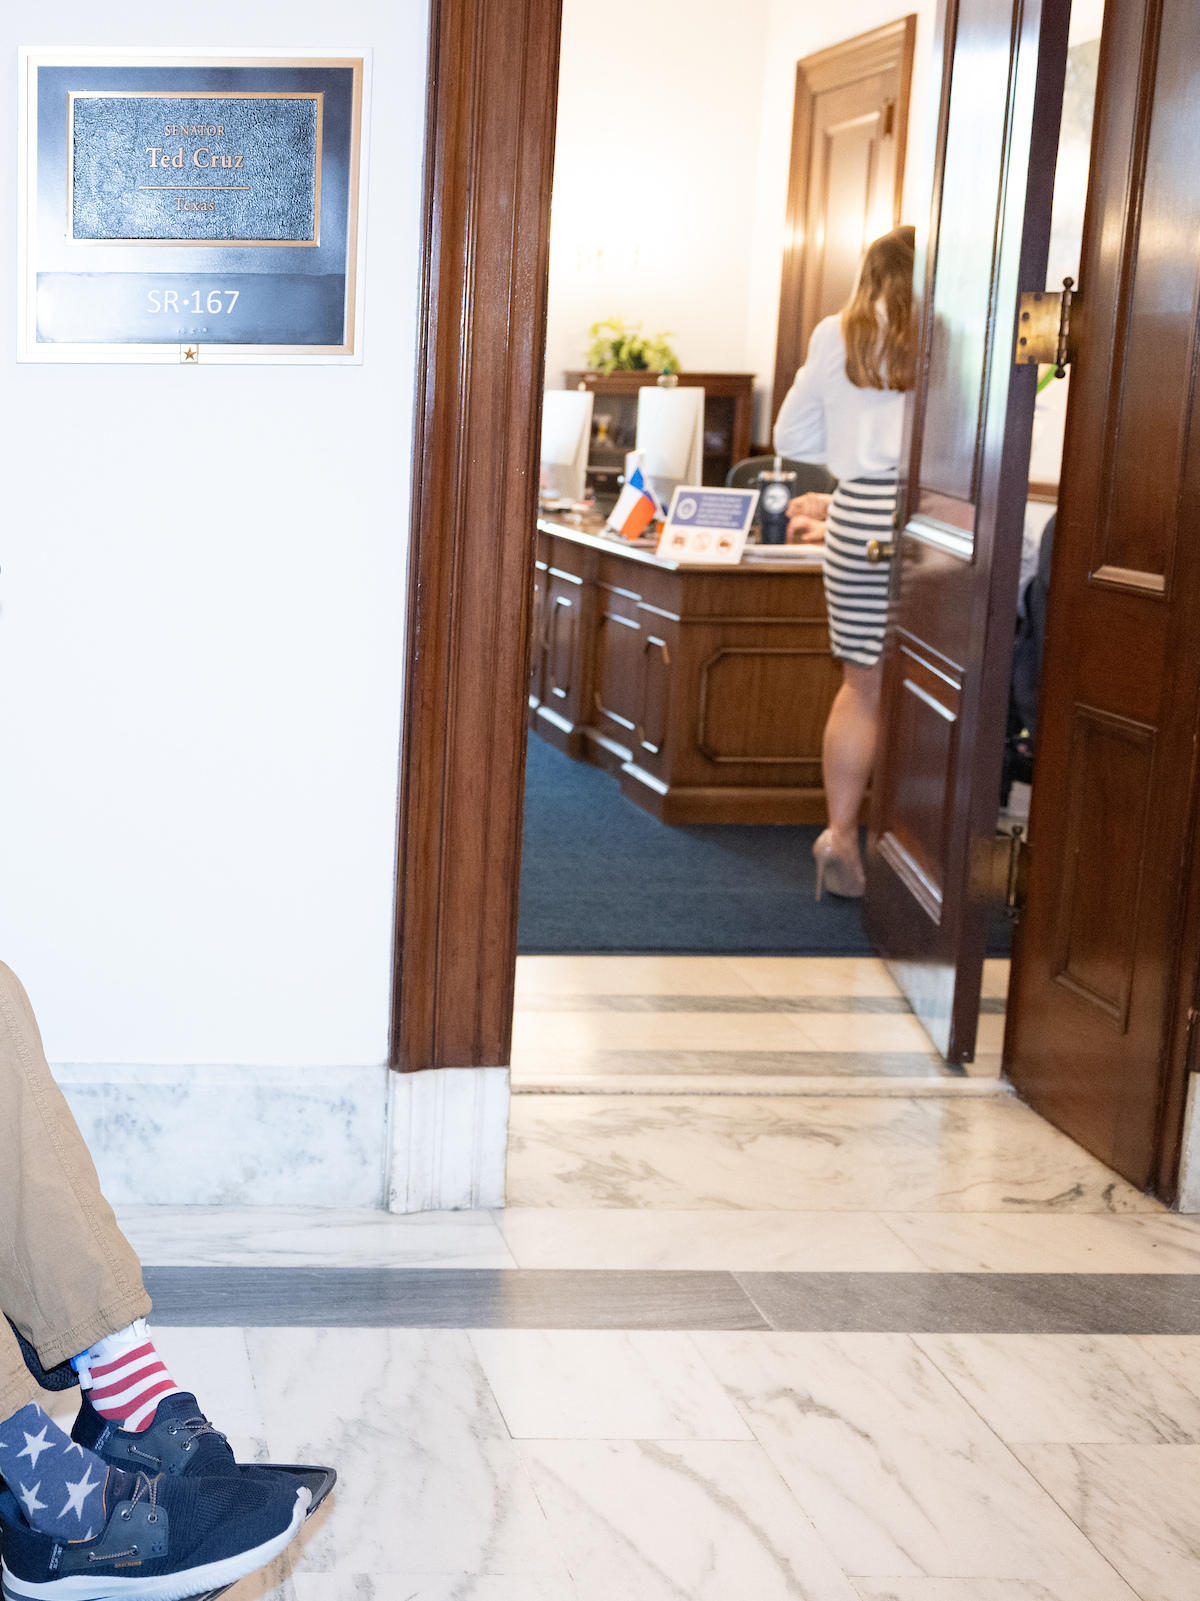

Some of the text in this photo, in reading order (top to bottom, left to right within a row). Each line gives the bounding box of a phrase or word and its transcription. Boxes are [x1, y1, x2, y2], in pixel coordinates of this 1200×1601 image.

[164, 125, 226, 137] SENATOR
[145, 147, 244, 168] Ted Cruz
[174, 197, 216, 211] Texas
